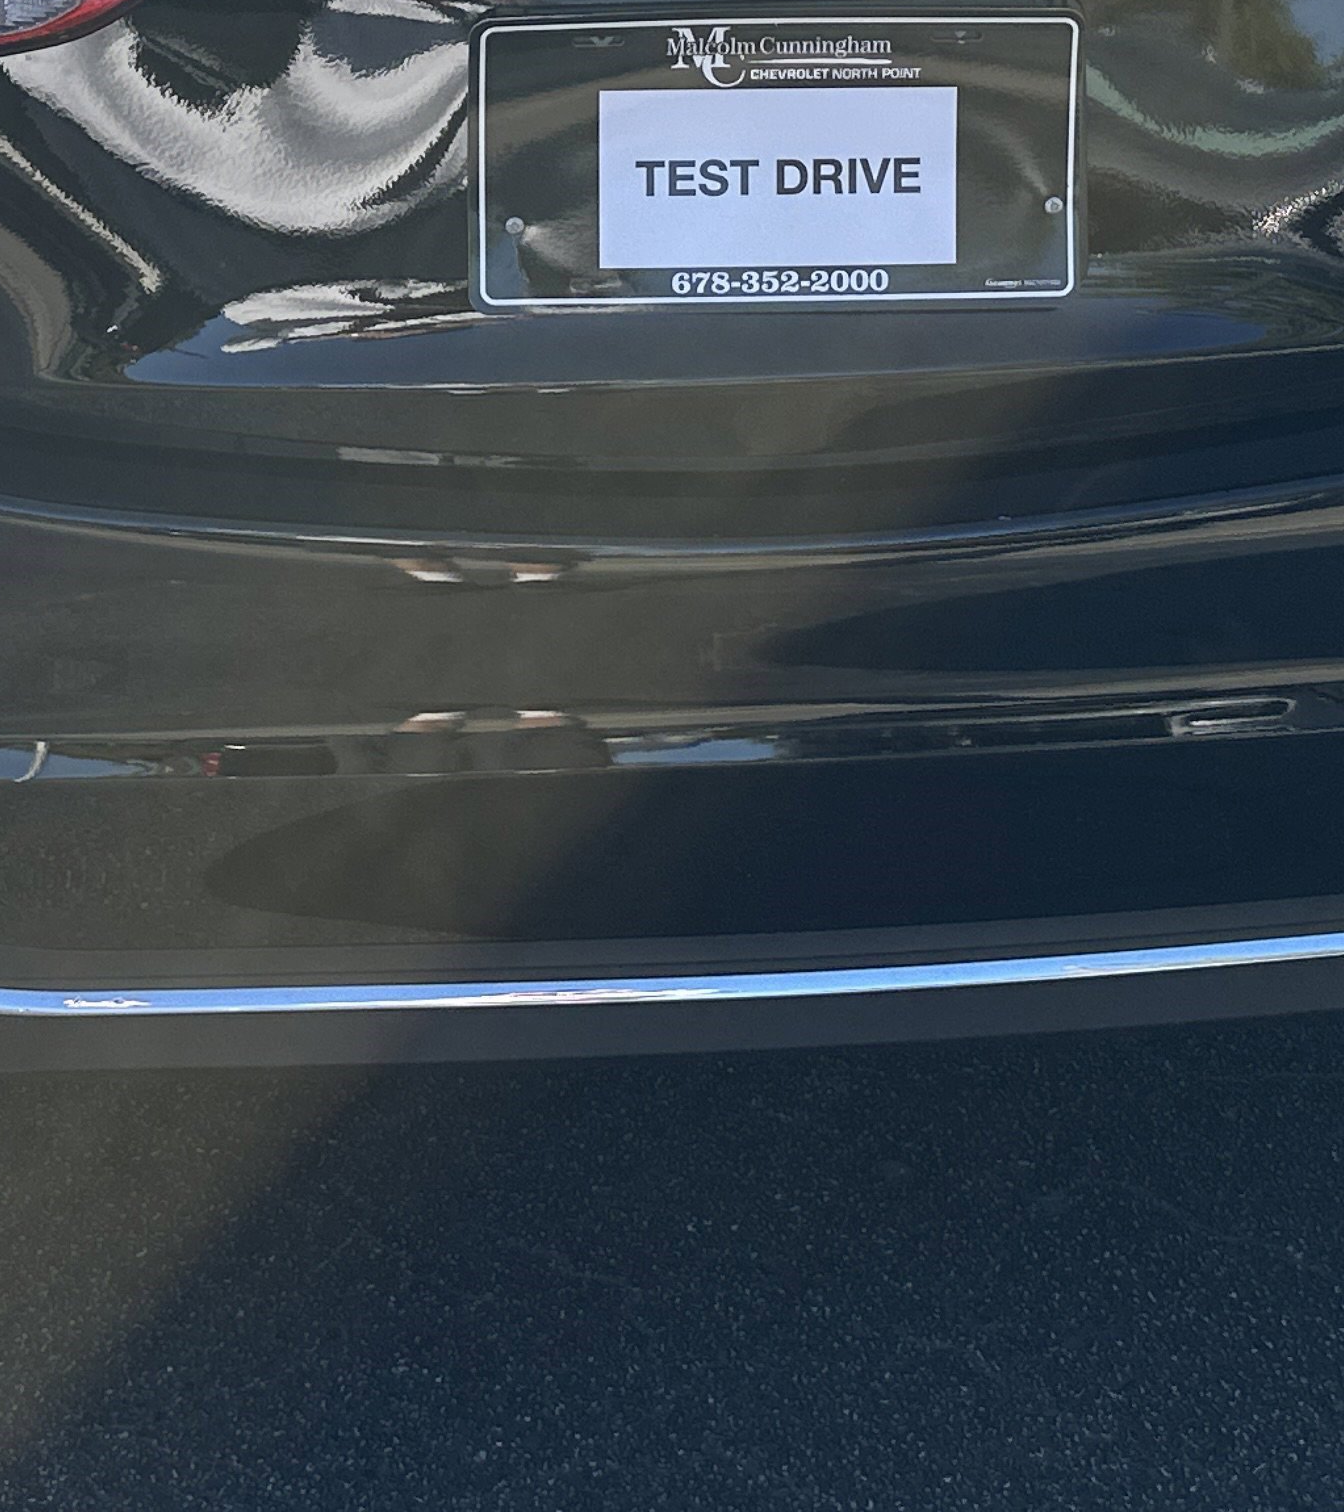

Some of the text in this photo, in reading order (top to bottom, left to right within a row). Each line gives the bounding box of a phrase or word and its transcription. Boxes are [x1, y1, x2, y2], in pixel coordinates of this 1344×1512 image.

[666, 35, 893, 57] Malcolm Cunningham
[750, 67, 923, 80] CHEVROLET NORTH POINT
[635, 157, 922, 197] TEST DRIVE
[671, 268, 890, 295] 678-352-2000
